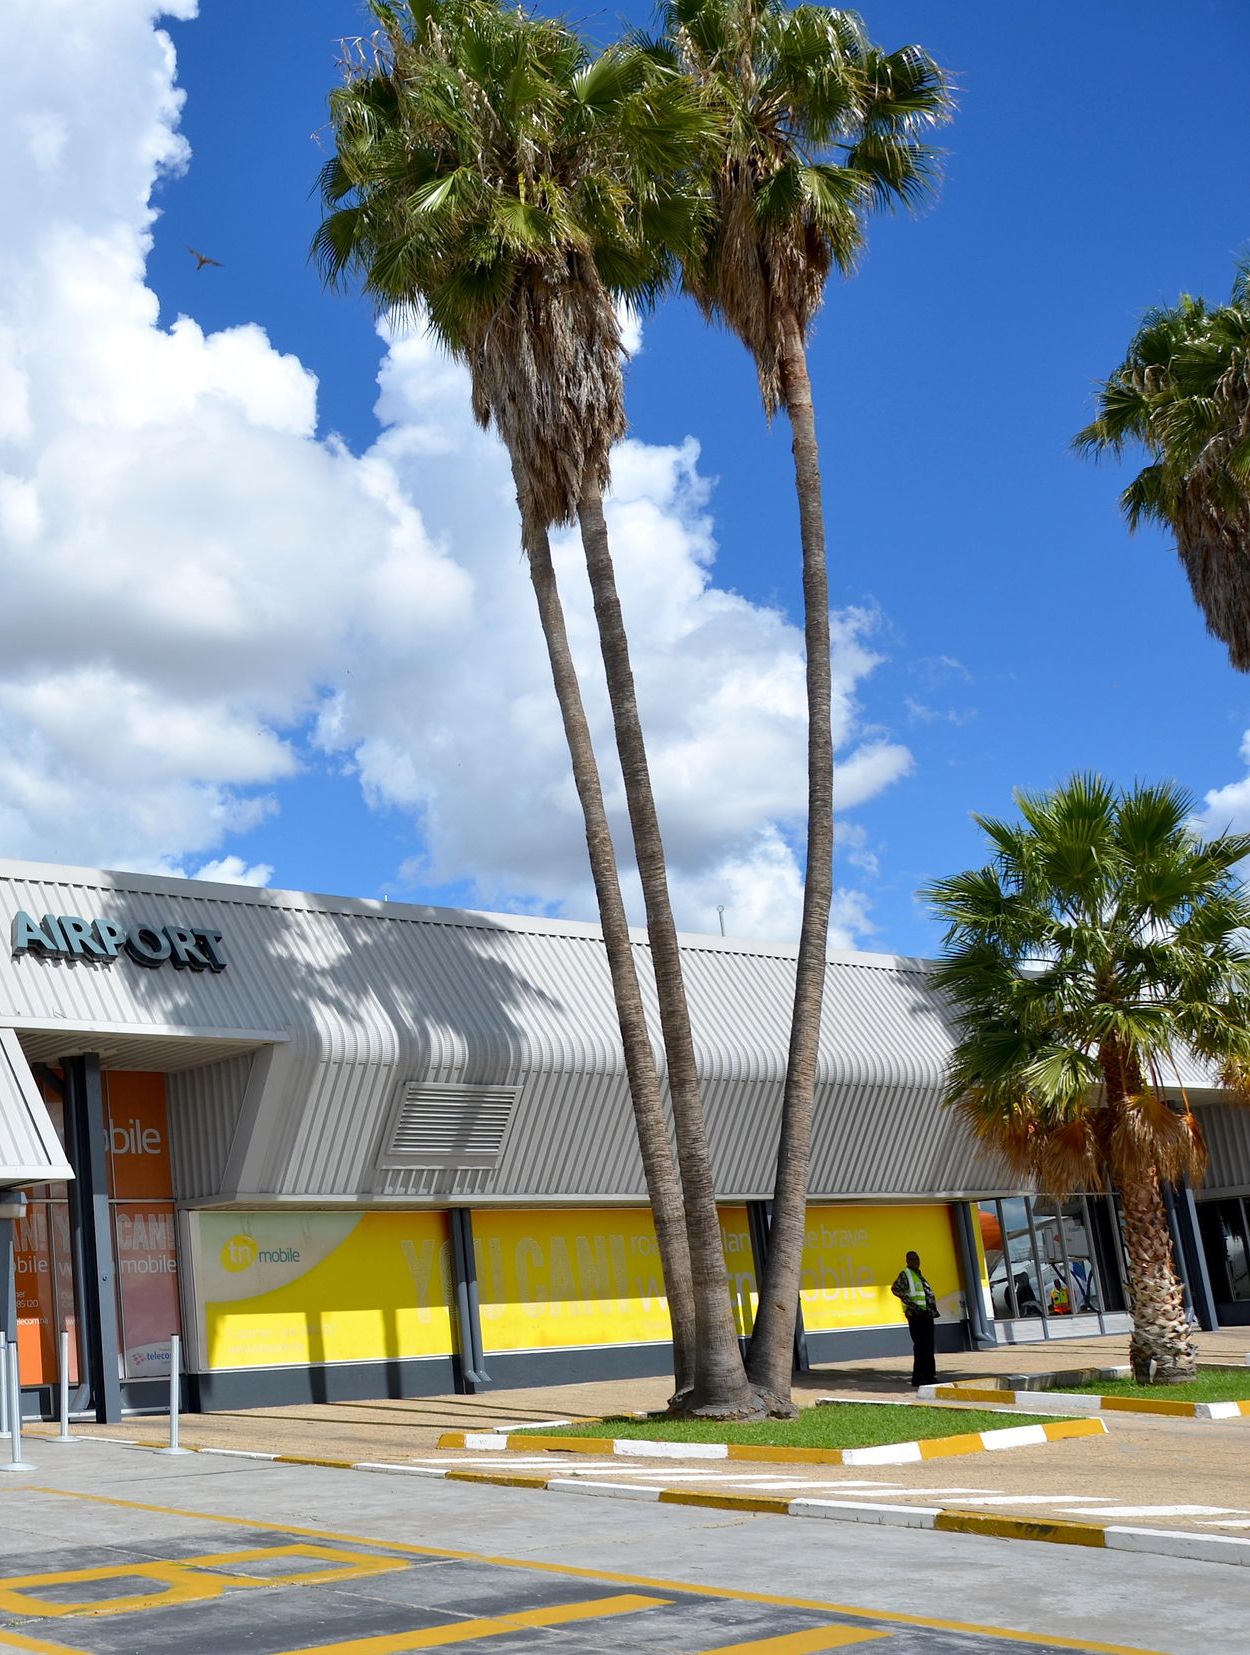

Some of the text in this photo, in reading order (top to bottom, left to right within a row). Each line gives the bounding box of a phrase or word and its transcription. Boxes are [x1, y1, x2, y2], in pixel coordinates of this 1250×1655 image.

[12, 910, 228, 973] AIRPORT
[103, 1119, 161, 1154] bile
[821, 1224, 870, 1249] brave
[14, 1255, 48, 1274] bile
[121, 1255, 177, 1274] mobile
[228, 1242, 301, 1264] tn mobile
